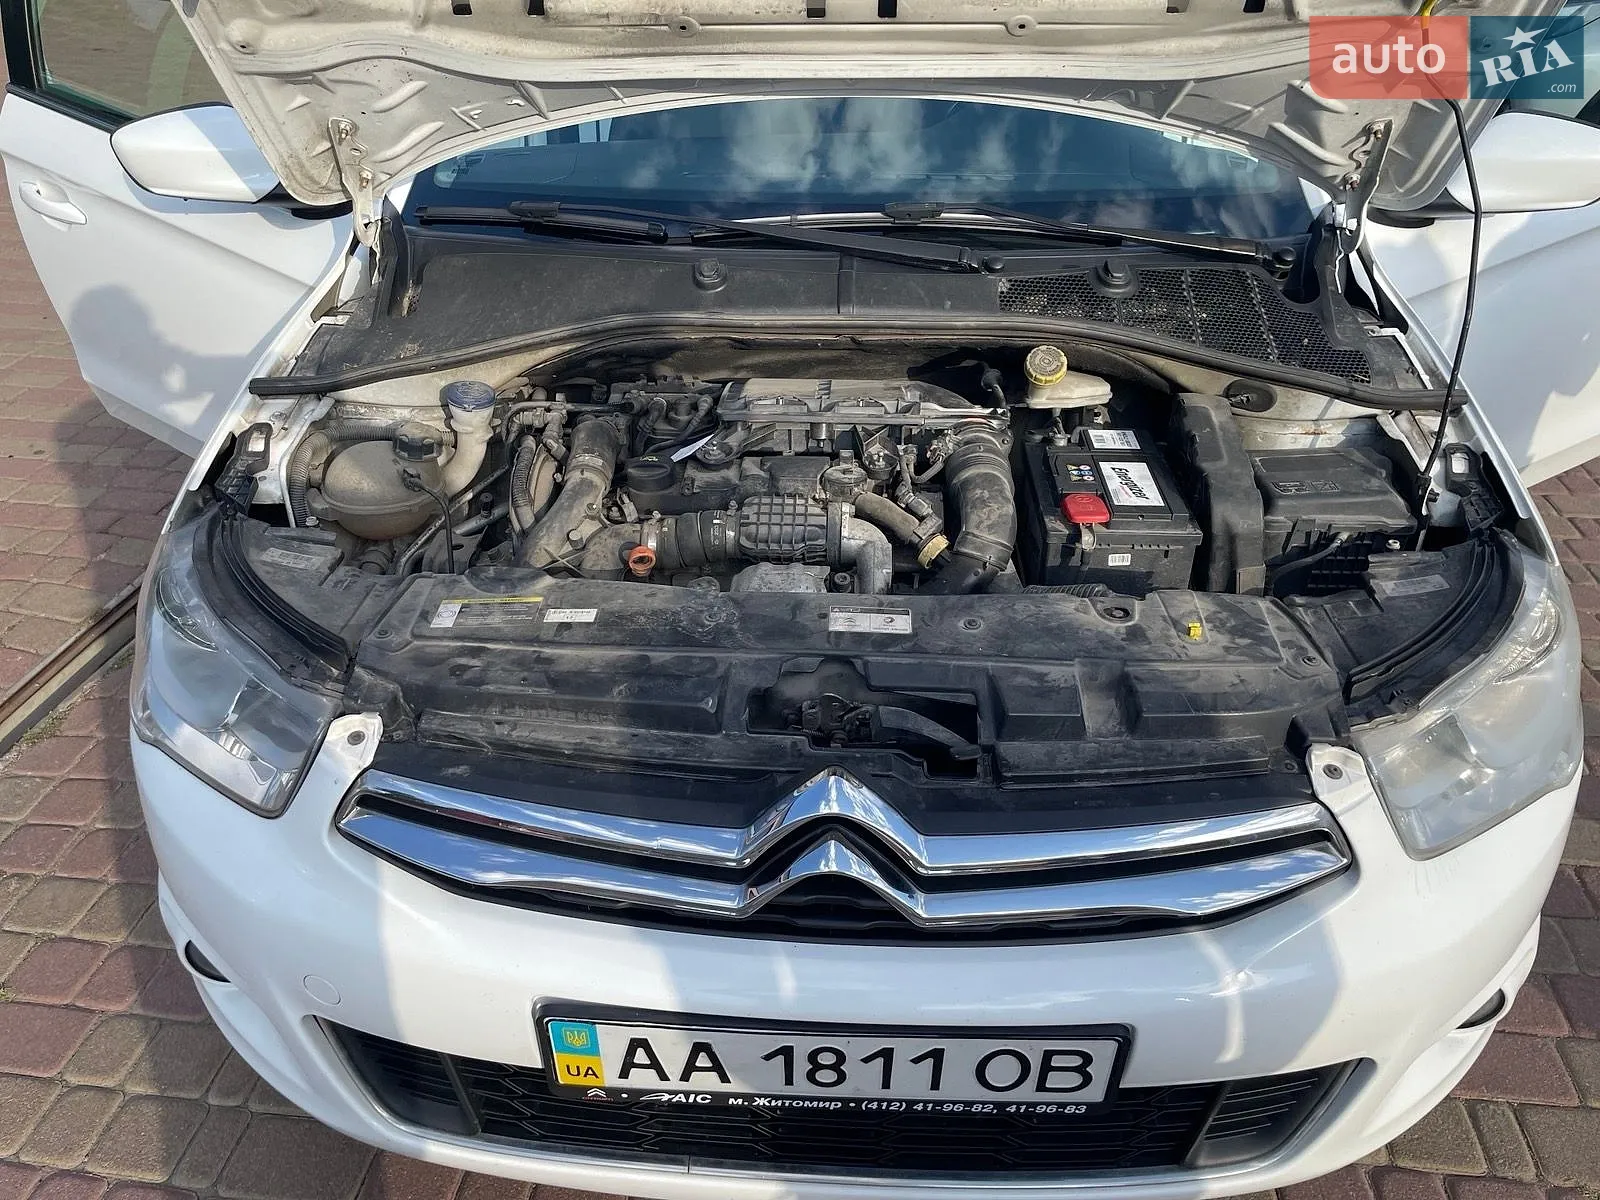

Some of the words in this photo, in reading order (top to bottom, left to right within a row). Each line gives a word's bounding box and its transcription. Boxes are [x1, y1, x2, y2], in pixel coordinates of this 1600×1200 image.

[1110, 466, 1150, 500] Energizer
[566, 1064, 600, 1079] UA
[618, 1037, 732, 1084] AA
[760, 1045, 946, 1091] 1811
[974, 1048, 1094, 1093] OB
[752, 1096, 842, 1110] Житомир
[861, 1100, 907, 1112] (412)
[912, 1102, 998, 1114] 41-96-82,
[1005, 1104, 1088, 1114] 41-96-83
